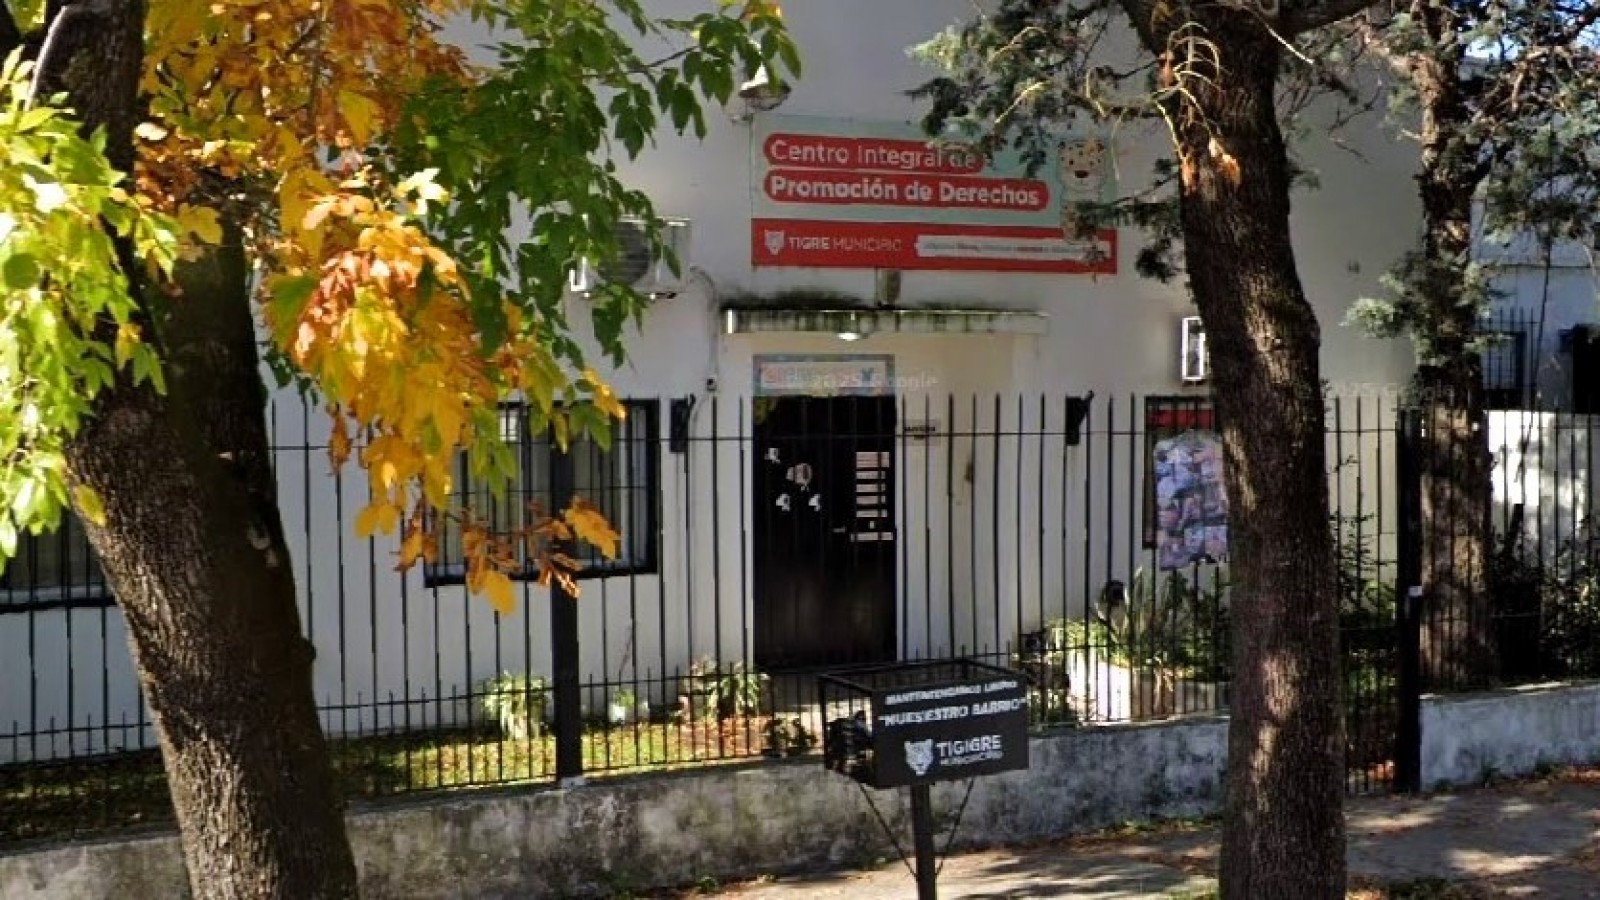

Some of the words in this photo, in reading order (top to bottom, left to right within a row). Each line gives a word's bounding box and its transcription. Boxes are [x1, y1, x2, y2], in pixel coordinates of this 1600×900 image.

[770, 139, 850, 163] Centro
[857, 144, 942, 170] Integral
[770, 175, 898, 201] Promoción
[904, 179, 930, 202] de
[939, 181, 1040, 207] Derechos
[788, 237, 830, 250] TIGRE
